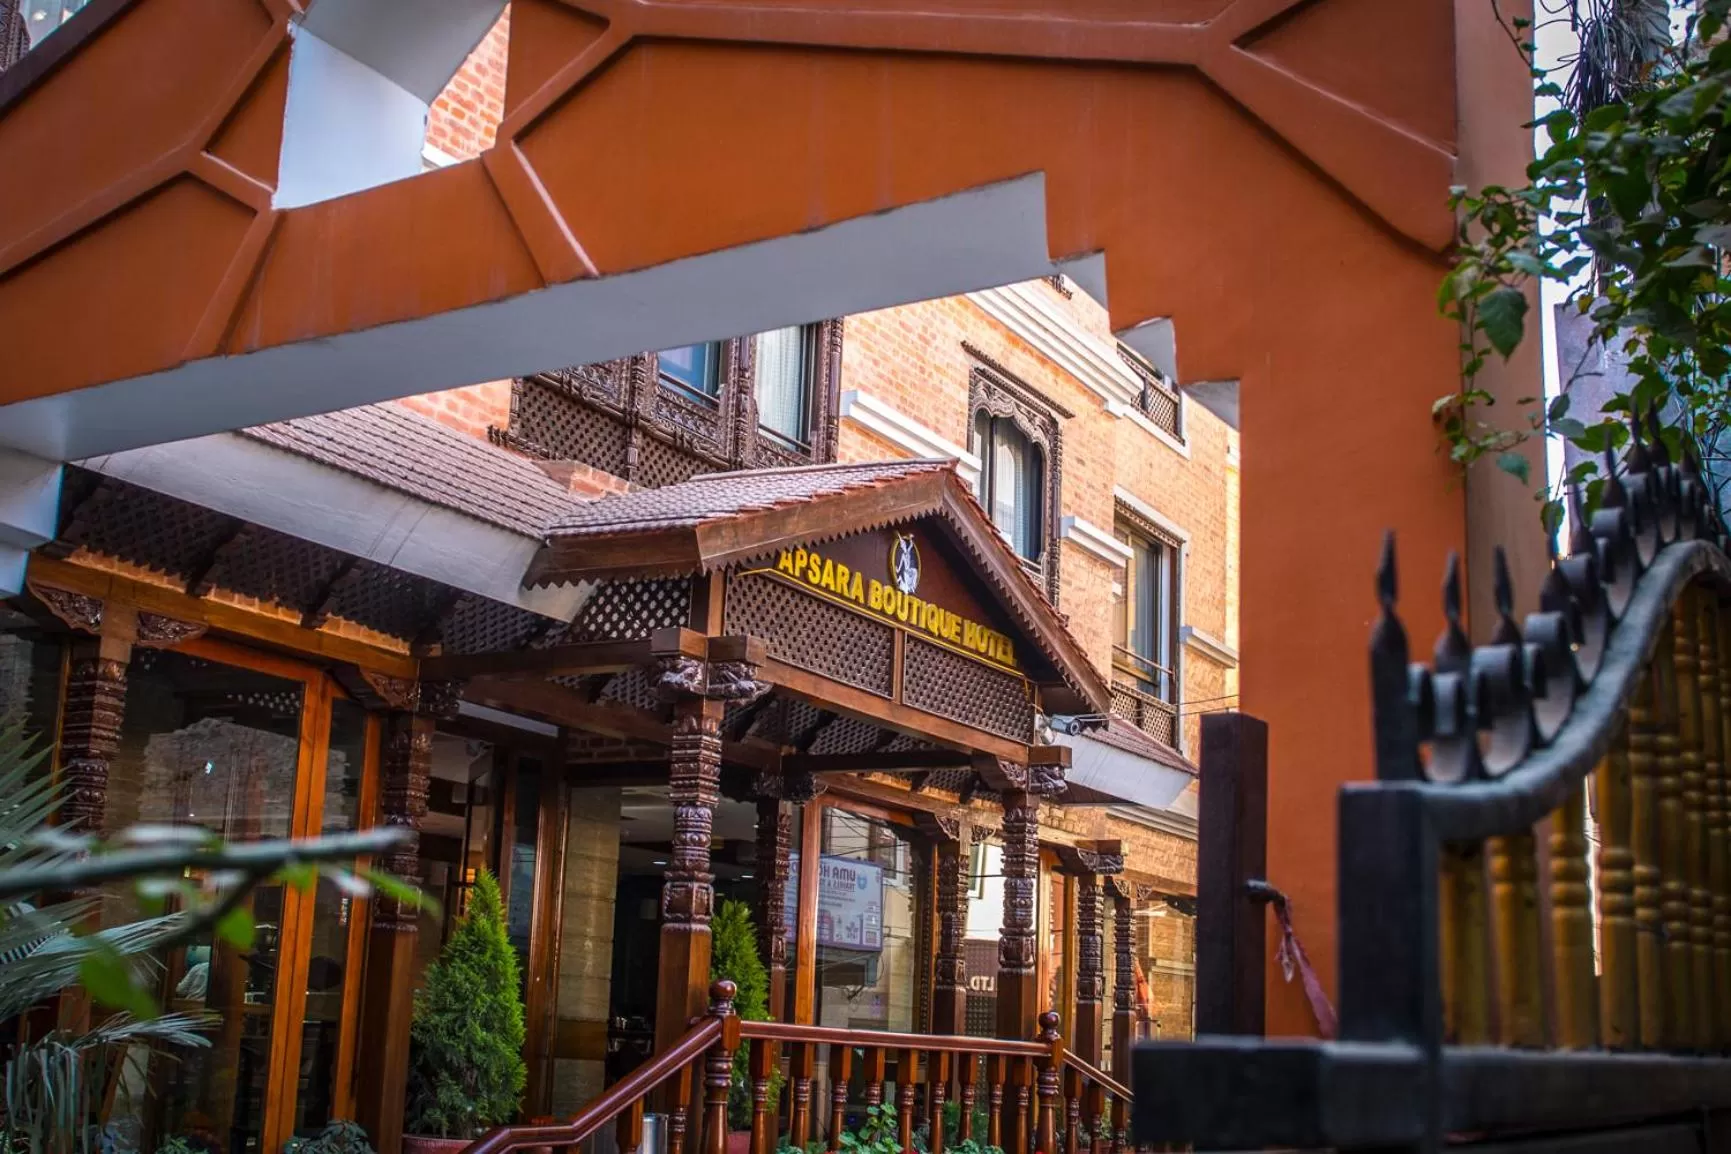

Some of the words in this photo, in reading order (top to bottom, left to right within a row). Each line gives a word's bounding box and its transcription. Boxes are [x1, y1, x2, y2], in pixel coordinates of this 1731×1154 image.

[778, 548, 864, 604] APSARA
[868, 580, 962, 642] BOUTIQUE
[962, 619, 1017, 667] HOTEL
